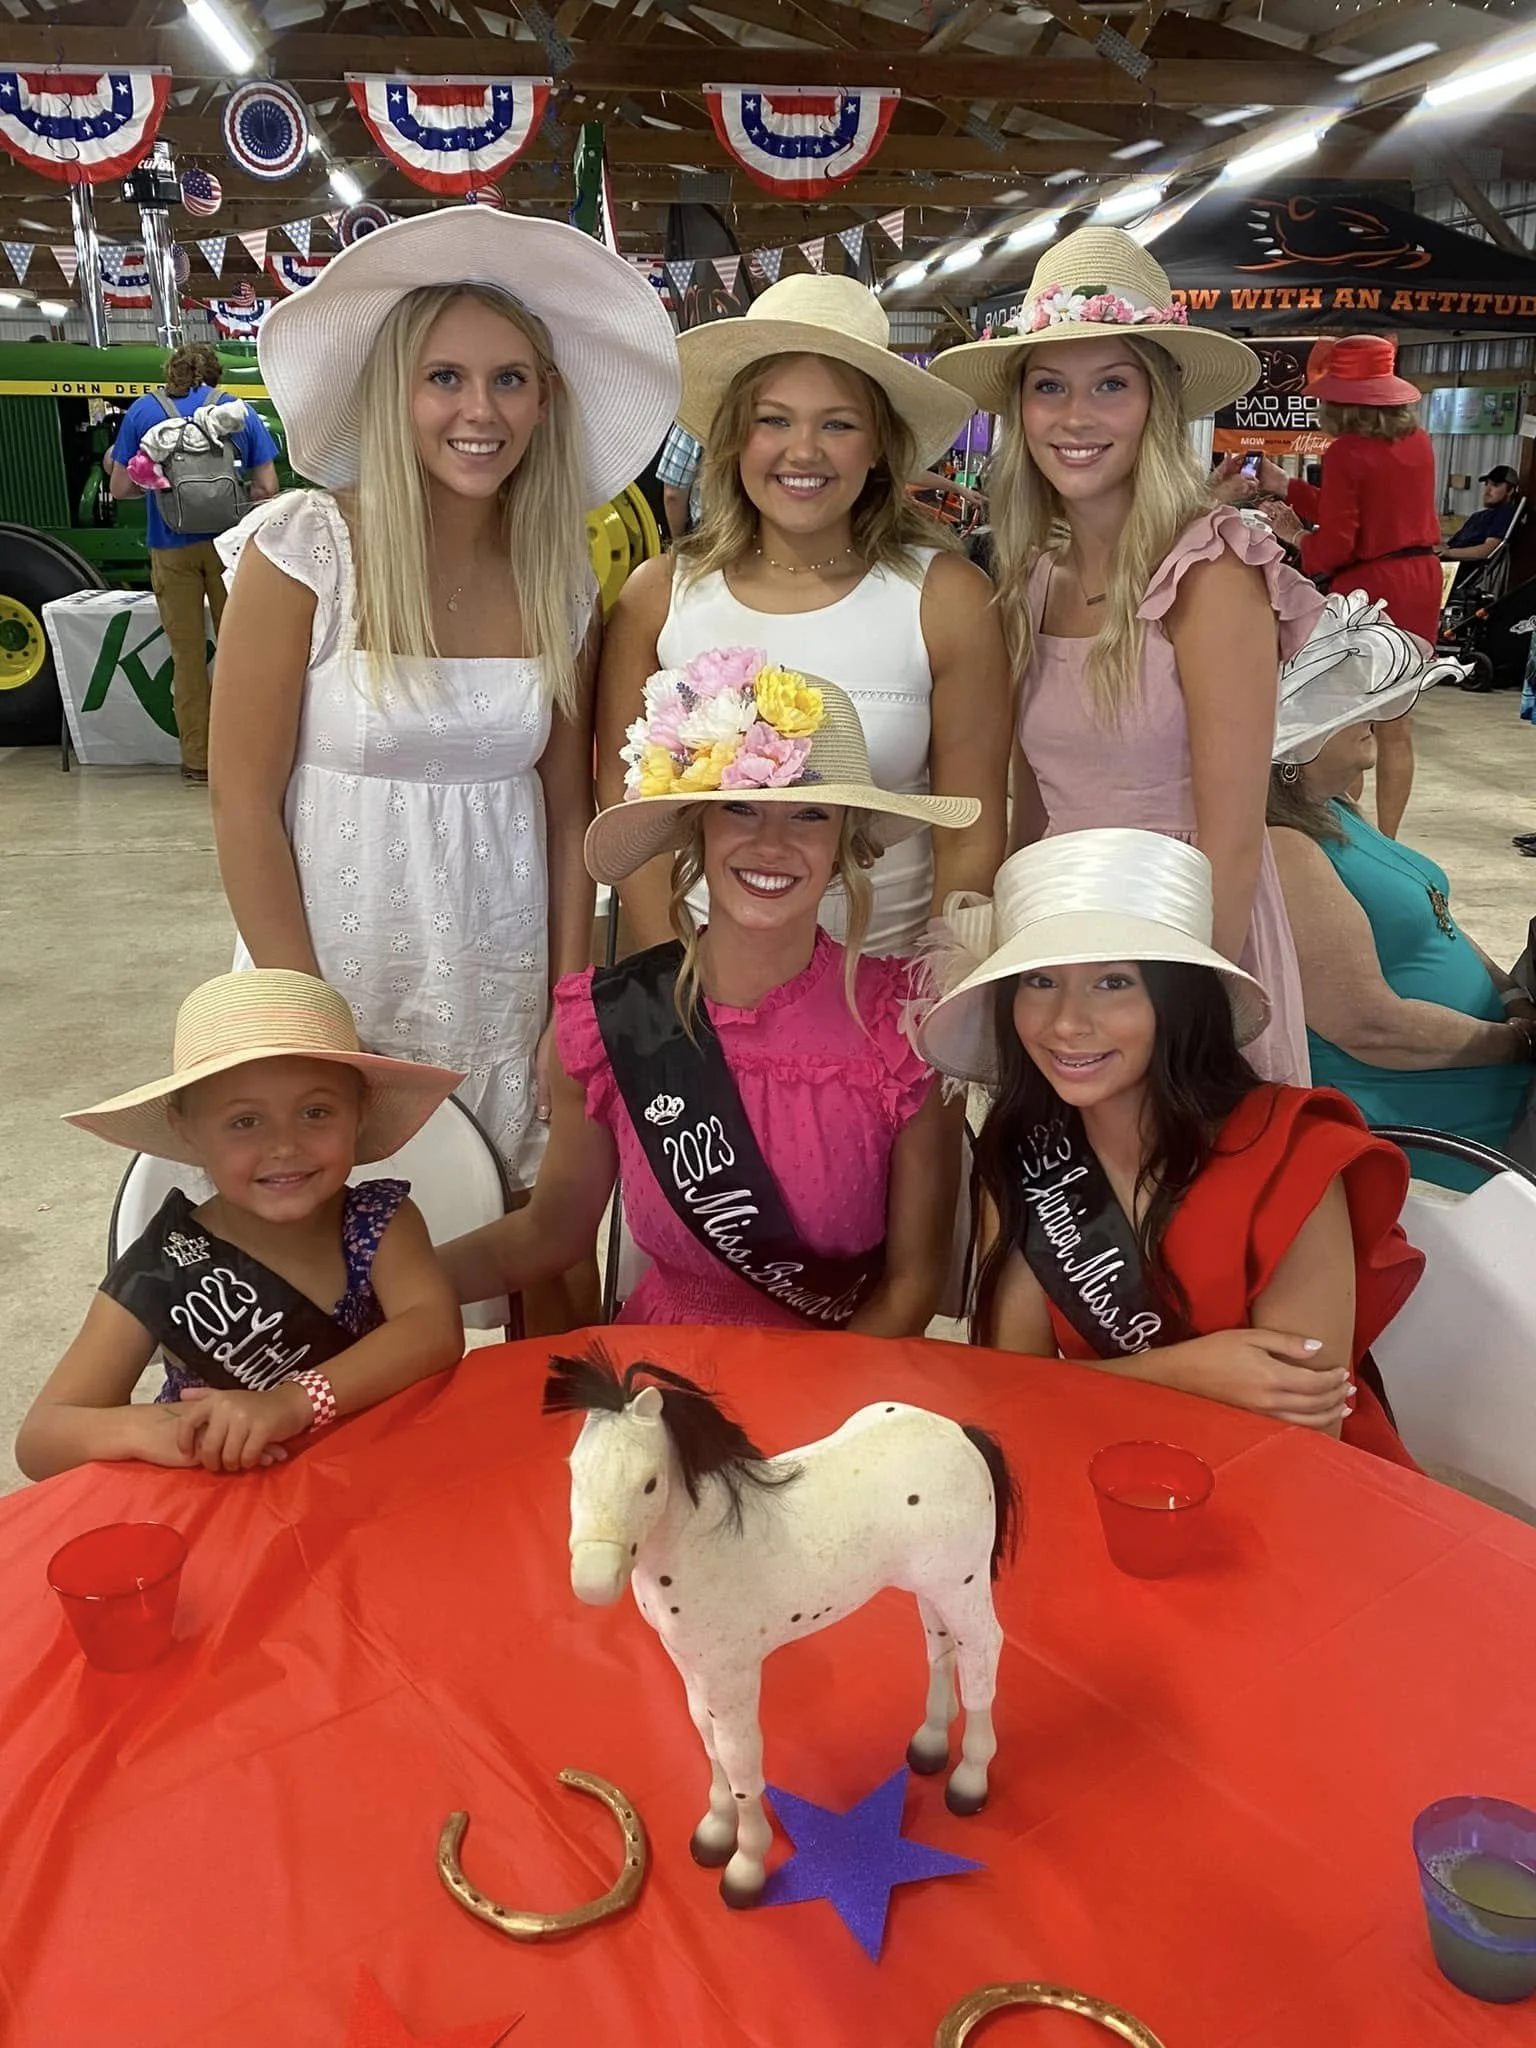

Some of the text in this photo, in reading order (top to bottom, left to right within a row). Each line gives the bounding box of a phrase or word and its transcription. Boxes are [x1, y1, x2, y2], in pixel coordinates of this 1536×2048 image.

[1170, 288, 1536, 316] OW WITH AN ATTITUD
[50, 383, 166, 395] JOHN DEE
[1235, 396, 1320, 410] BAD BO
[1235, 412, 1321, 428] MOWER
[1240, 437, 1265, 446] MOW
[663, 1115, 735, 1190] 2023
[1018, 1118, 1072, 1184] 023
[684, 1186, 760, 1264] Miss
[1025, 1166, 1089, 1260] Junior
[1063, 1247, 1125, 1329] Miss
[170, 1267, 258, 1352] 2023
